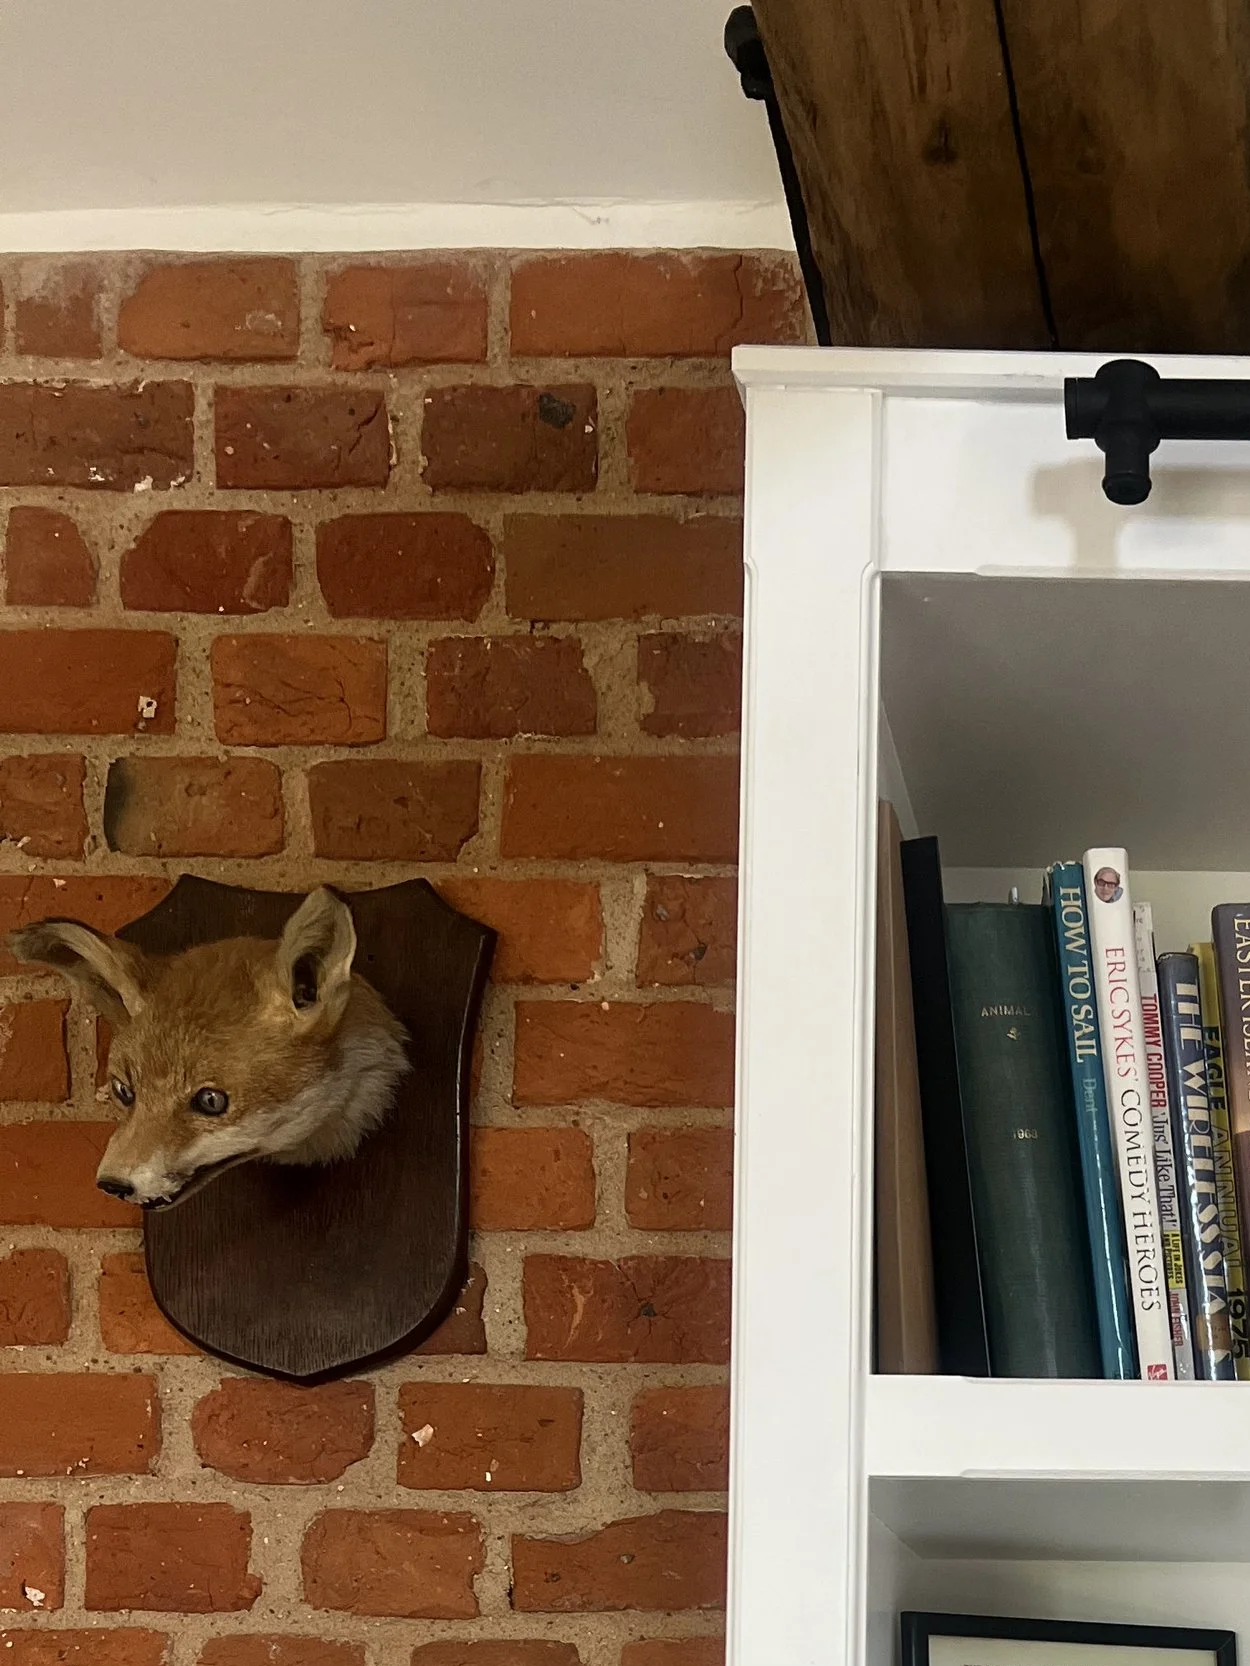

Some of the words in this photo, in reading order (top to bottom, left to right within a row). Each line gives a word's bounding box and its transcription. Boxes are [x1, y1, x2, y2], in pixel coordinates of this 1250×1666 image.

[1059, 886, 1088, 956] HOW
[1067, 963, 1092, 1000] TO
[1105, 947, 1130, 1005] ERIC
[1071, 1004, 1098, 1063] SAIL
[1111, 1008, 1140, 1082] SYKES'
[1141, 993, 1162, 1048] TOMMY
[1082, 1078, 1098, 1113] Dent
[1147, 1053, 1168, 1108] COOPER
[1203, 1026, 1227, 1111] EAGLE
[1120, 1089, 1151, 1203] COMEDY
[1155, 1147, 1174, 1183] Like
[1212, 1125, 1241, 1274] ANNUAL
[1132, 1211, 1162, 1311] HEROES
[1172, 1316, 1184, 1347] FISHER
[1229, 1287, 1250, 1359] 1975
